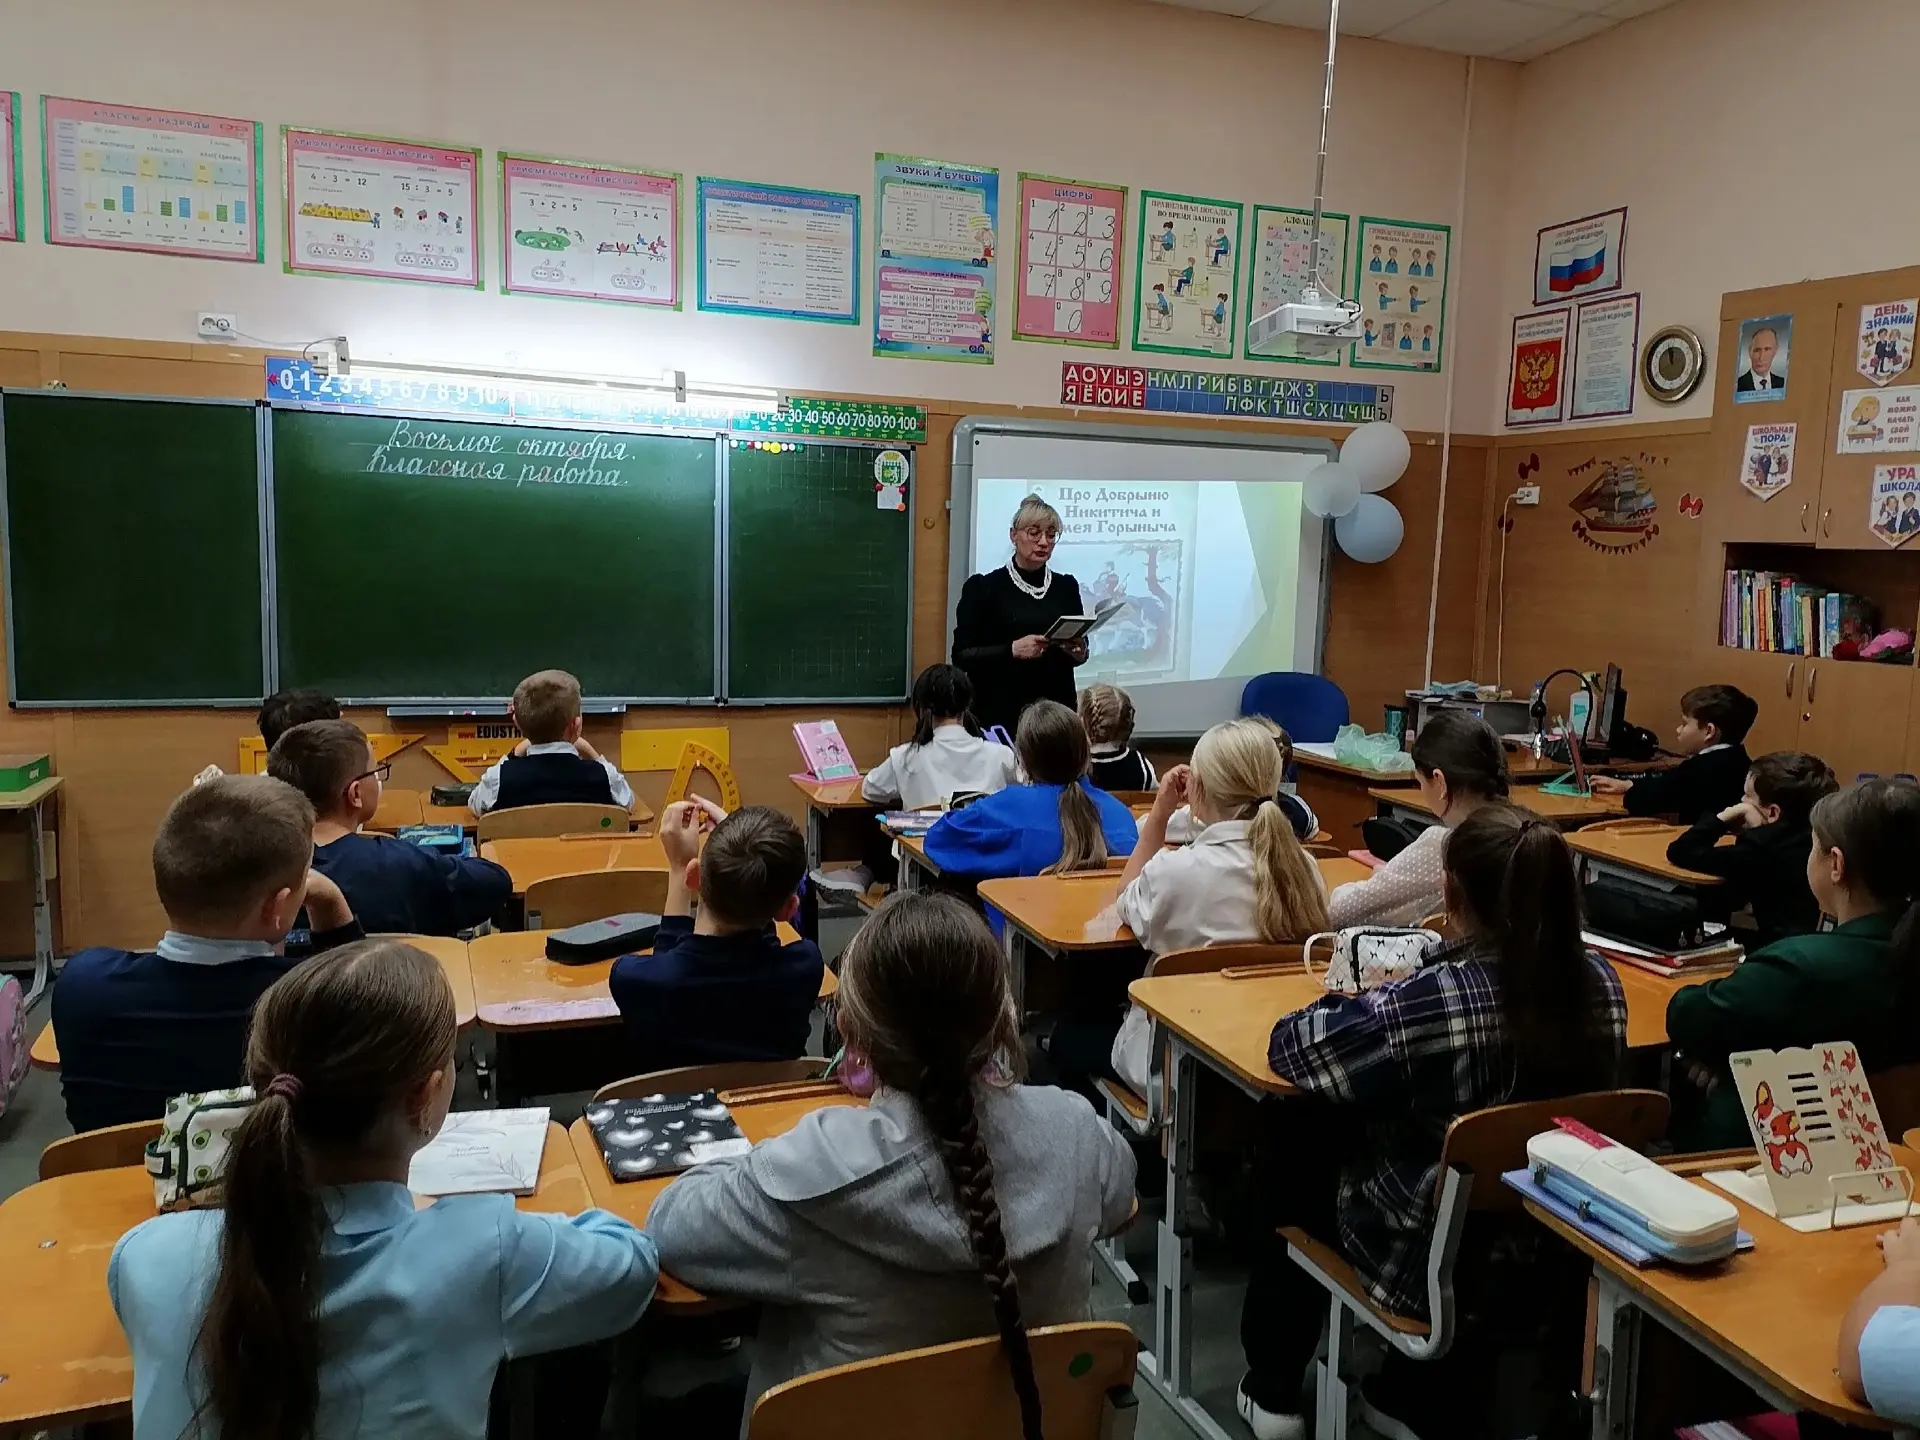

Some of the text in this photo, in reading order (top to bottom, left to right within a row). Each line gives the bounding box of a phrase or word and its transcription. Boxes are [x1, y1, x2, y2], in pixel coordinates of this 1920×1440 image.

[332, 175, 338, 183] 3
[358, 178, 367, 186] 12
[896, 166, 930, 177] ЗВУКИ
[945, 172, 983, 183] БУКВЫ
[401, 182, 410, 191] 15
[1054, 188, 1094, 200] ЦИФРЫ
[529, 199, 535, 207] 3
[551, 201, 556, 209] 2
[1060, 203, 1065, 211] 2
[1089, 207, 1094, 215] 3
[1169, 212, 1192, 220] ВРЕМЯ
[1074, 212, 1087, 236] 2
[1102, 215, 1115, 239] 3
[1029, 232, 1034, 240] 4
[1059, 236, 1063, 244] 5
[1087, 239, 1092, 248] 6
[1045, 241, 1057, 265] 4
[1072, 244, 1086, 268] 5
[1100, 248, 1113, 271] 6
[1029, 266, 1034, 274] 7
[1058, 269, 1062, 277] 8
[1086, 272, 1091, 280] 9
[1044, 274, 1056, 297] 7
[1070, 277, 1084, 300] 8
[1099, 280, 1112, 303] 9
[1873, 304, 1908, 318] ДЕНЬ
[1068, 309, 1082, 333] 0
[1865, 312, 1914, 330] ЗНАНИЙ
[280, 369, 497, 404] 0 1 2 3 4 5 6 7 8 9 10
[1887, 405, 1917, 413] МОЖНО
[789, 409, 802, 423] 30
[805, 409, 818, 424] 40
[821, 411, 835, 425] 50
[837, 412, 850, 427] 60
[852, 413, 866, 428] 70
[867, 414, 881, 429] 80
[882, 415, 896, 429] 90
[899, 416, 917, 431] 100
[389, 419, 504, 453] Восьмое
[1752, 426, 1794, 435] ШКОЛЬНАЯ
[1760, 434, 1786, 443] ПОРА
[1888, 436, 1910, 444] ОТВЕТ
[366, 444, 509, 479] Классная
[1887, 467, 1915, 480] УРА
[1059, 487, 1169, 504] Про Добрыню
[1064, 505, 1161, 518] Никитича и
[1062, 520, 1177, 536] мея Горыныча
